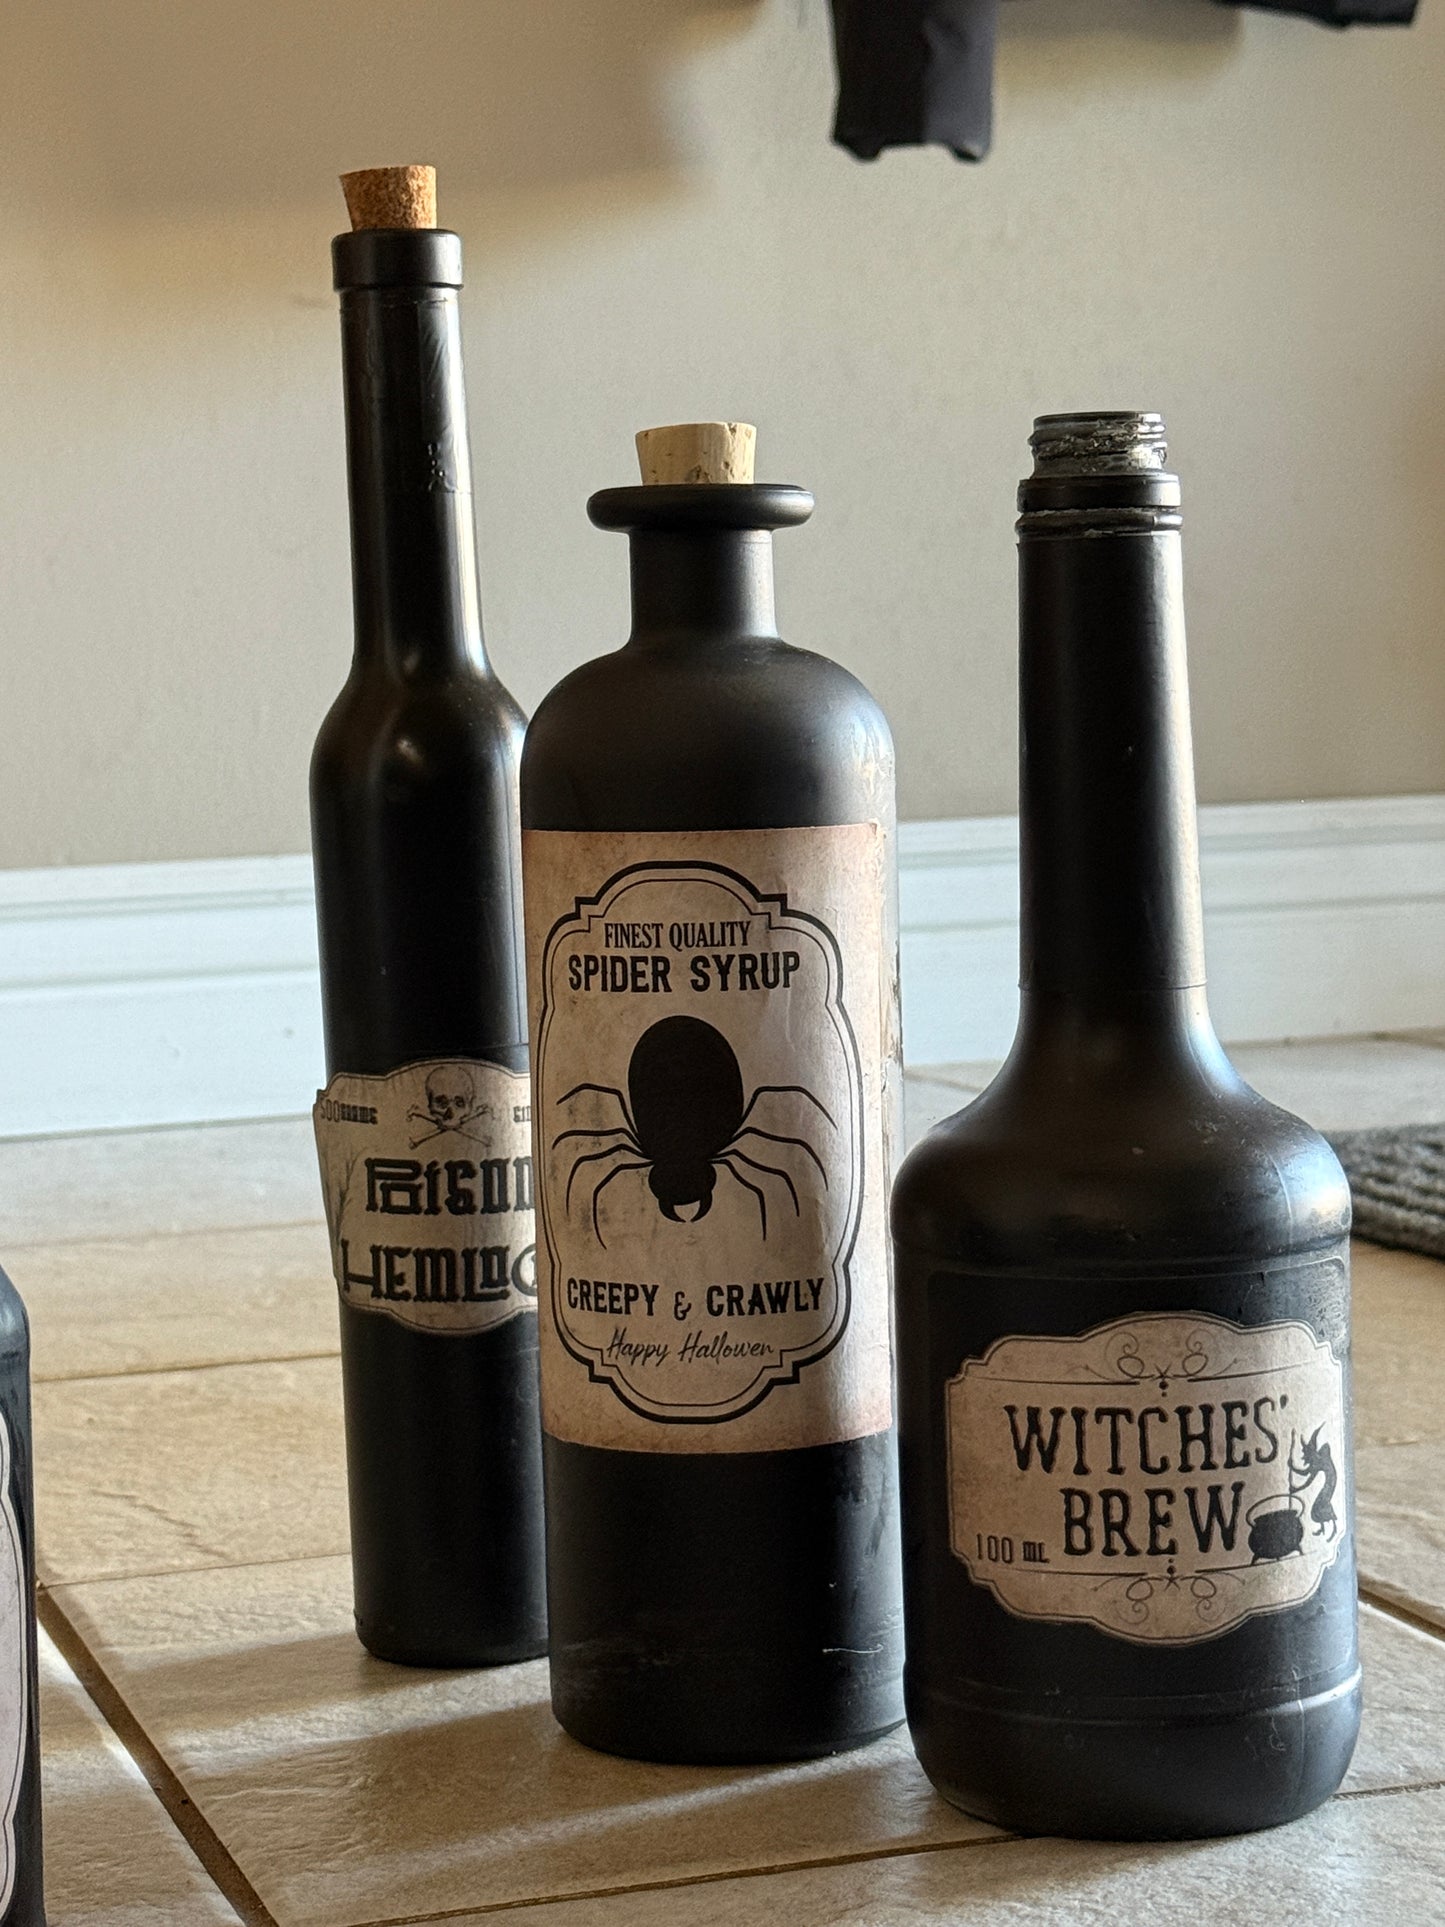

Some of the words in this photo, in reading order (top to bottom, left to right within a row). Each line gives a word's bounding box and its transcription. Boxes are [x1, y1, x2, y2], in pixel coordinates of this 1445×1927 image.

[604, 922, 663, 948] FINEST
[669, 920, 751, 951] QUALITY
[568, 954, 672, 993] SPIDER
[690, 950, 800, 993] SYRUP
[566, 1277, 659, 1316] CREEPY
[673, 1291, 691, 1321] &
[706, 1278, 824, 1317] CRAWLY
[606, 1327, 669, 1367] Happy
[1003, 1394, 1288, 1476] WITCHES'
[1059, 1480, 1246, 1557] BREW
[976, 1533, 1013, 1564] 100
